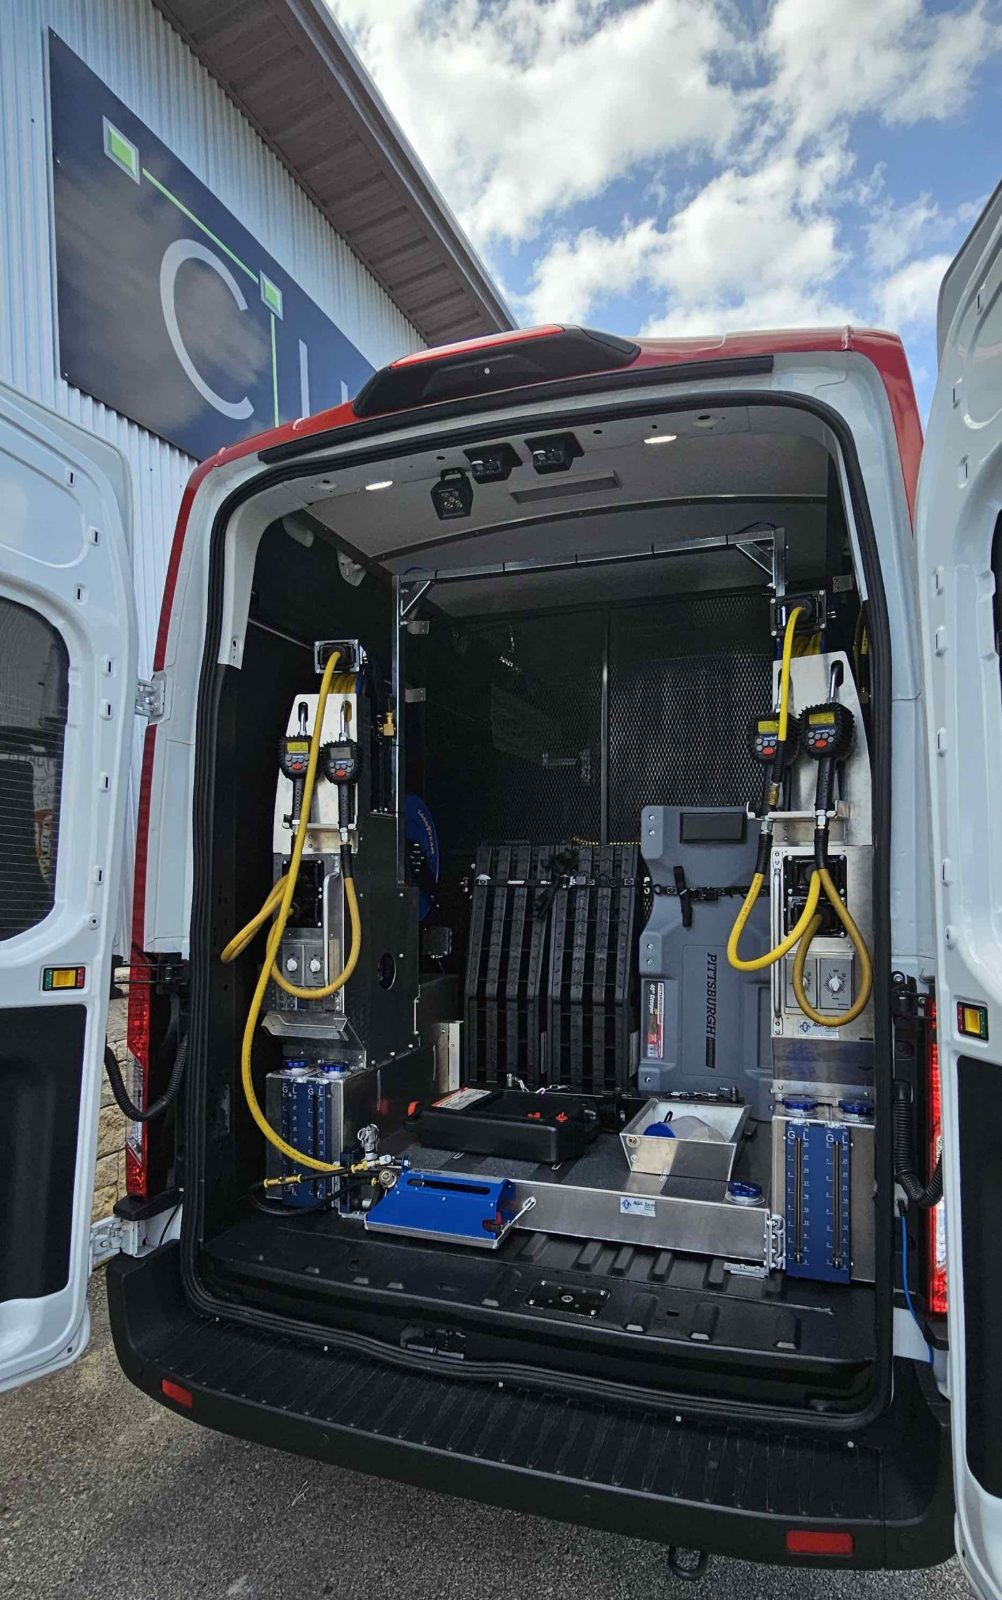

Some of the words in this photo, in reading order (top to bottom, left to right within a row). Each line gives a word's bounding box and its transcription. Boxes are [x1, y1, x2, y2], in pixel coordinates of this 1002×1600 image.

[706, 953, 717, 1039] PITTSBURGH
[787, 1130, 796, 1139] G
[802, 1131, 809, 1141] L
[825, 1134, 834, 1143] G
[841, 1135, 848, 1144] L
